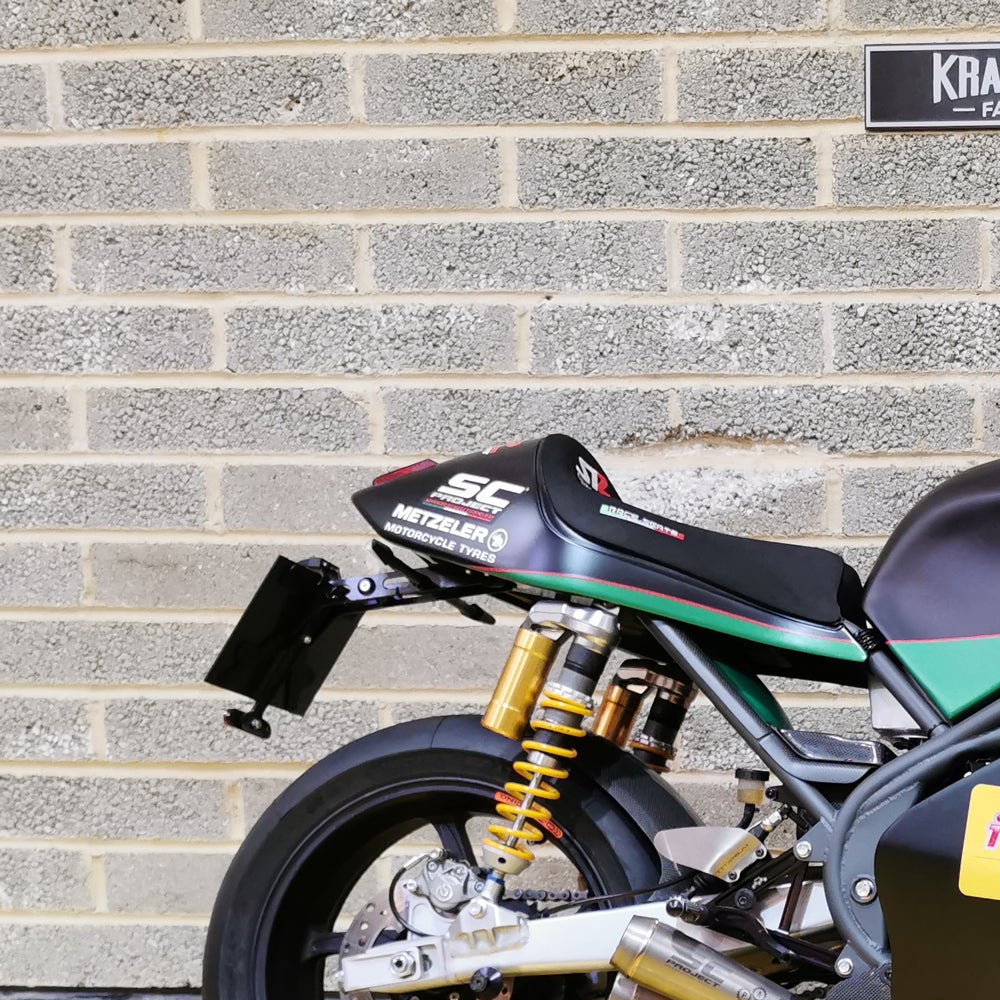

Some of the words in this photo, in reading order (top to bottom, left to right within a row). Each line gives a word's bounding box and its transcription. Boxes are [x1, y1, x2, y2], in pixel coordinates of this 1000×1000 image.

[430, 491, 503, 515] PROJECT
[437, 472, 526, 509] SC
[391, 502, 490, 544] METZELER
[384, 521, 457, 551] MOTORCYCLE
[459, 543, 497, 564] TYRES
[665, 957, 721, 988] PROJECT
